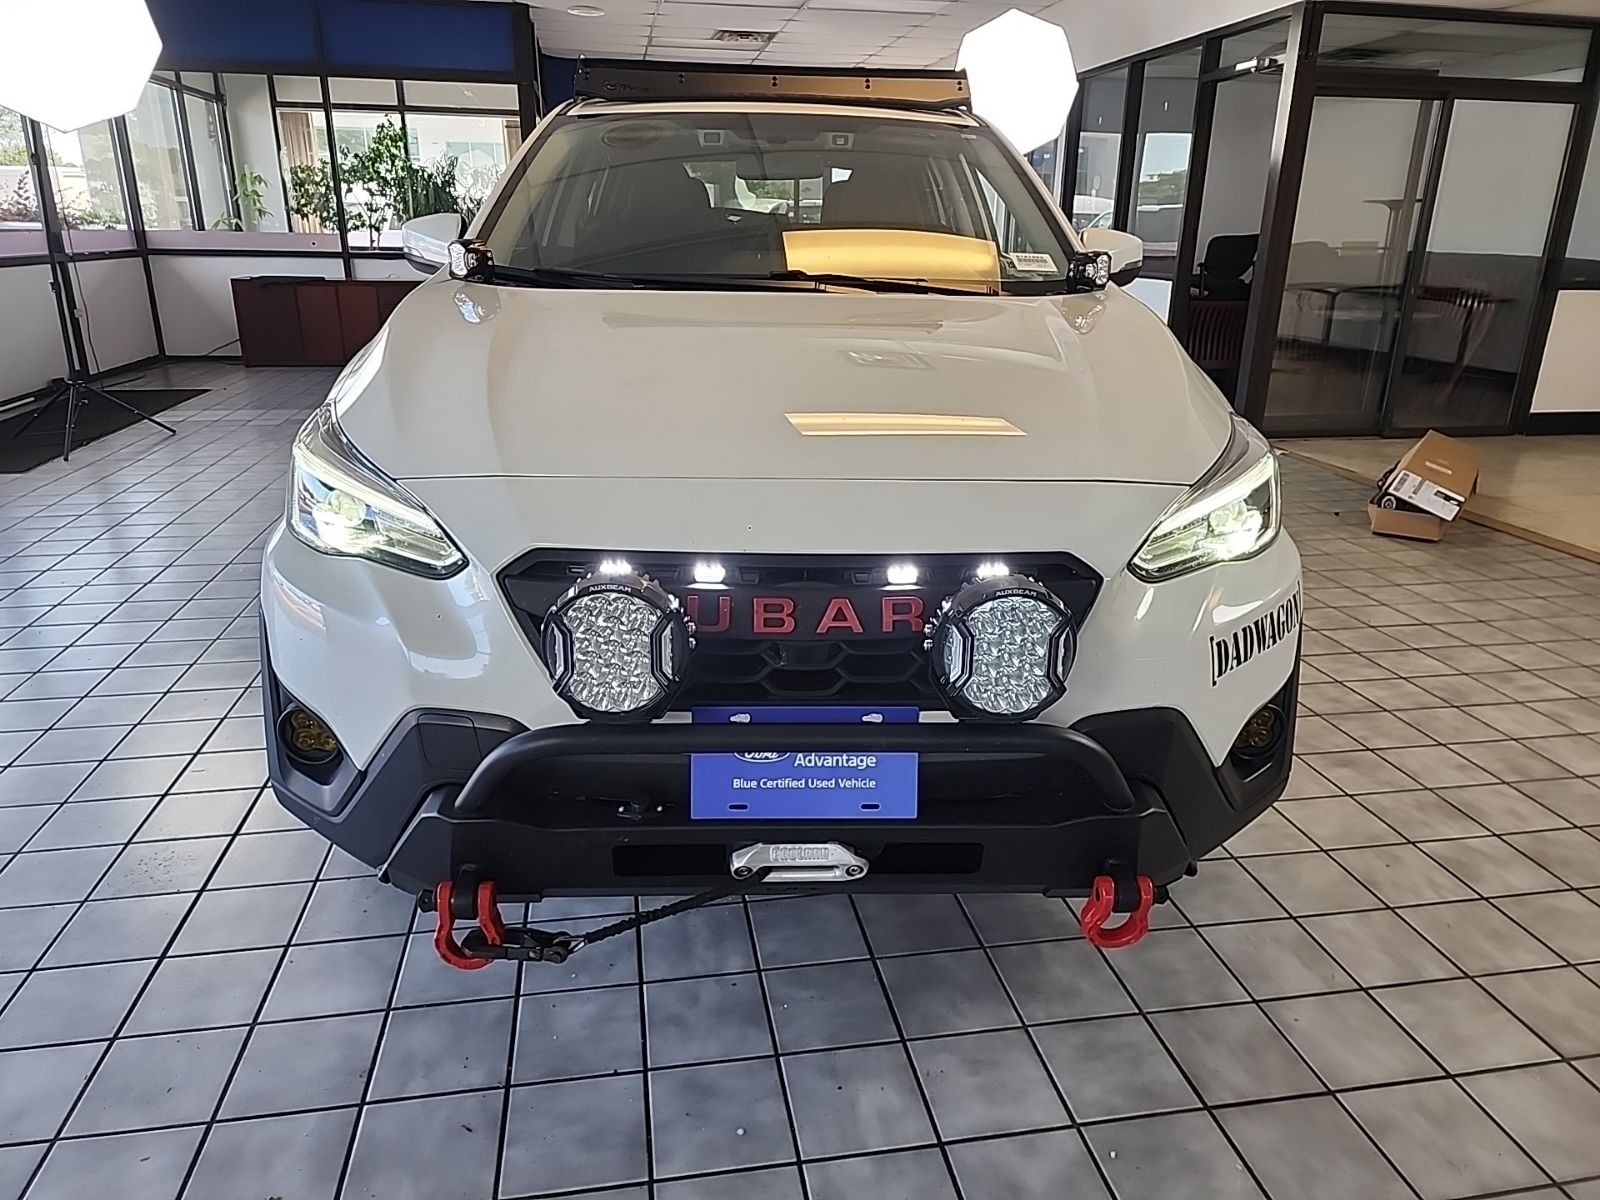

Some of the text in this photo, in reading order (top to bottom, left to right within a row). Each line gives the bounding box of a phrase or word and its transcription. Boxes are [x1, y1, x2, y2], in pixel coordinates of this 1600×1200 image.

[589, 584, 632, 593] AUXBEAM
[995, 589, 1037, 597] AUXBEAM
[686, 595, 924, 634] UBAR
[794, 753, 877, 769] Advantage
[733, 778, 876, 789] Blue Certified Used Vehicle
